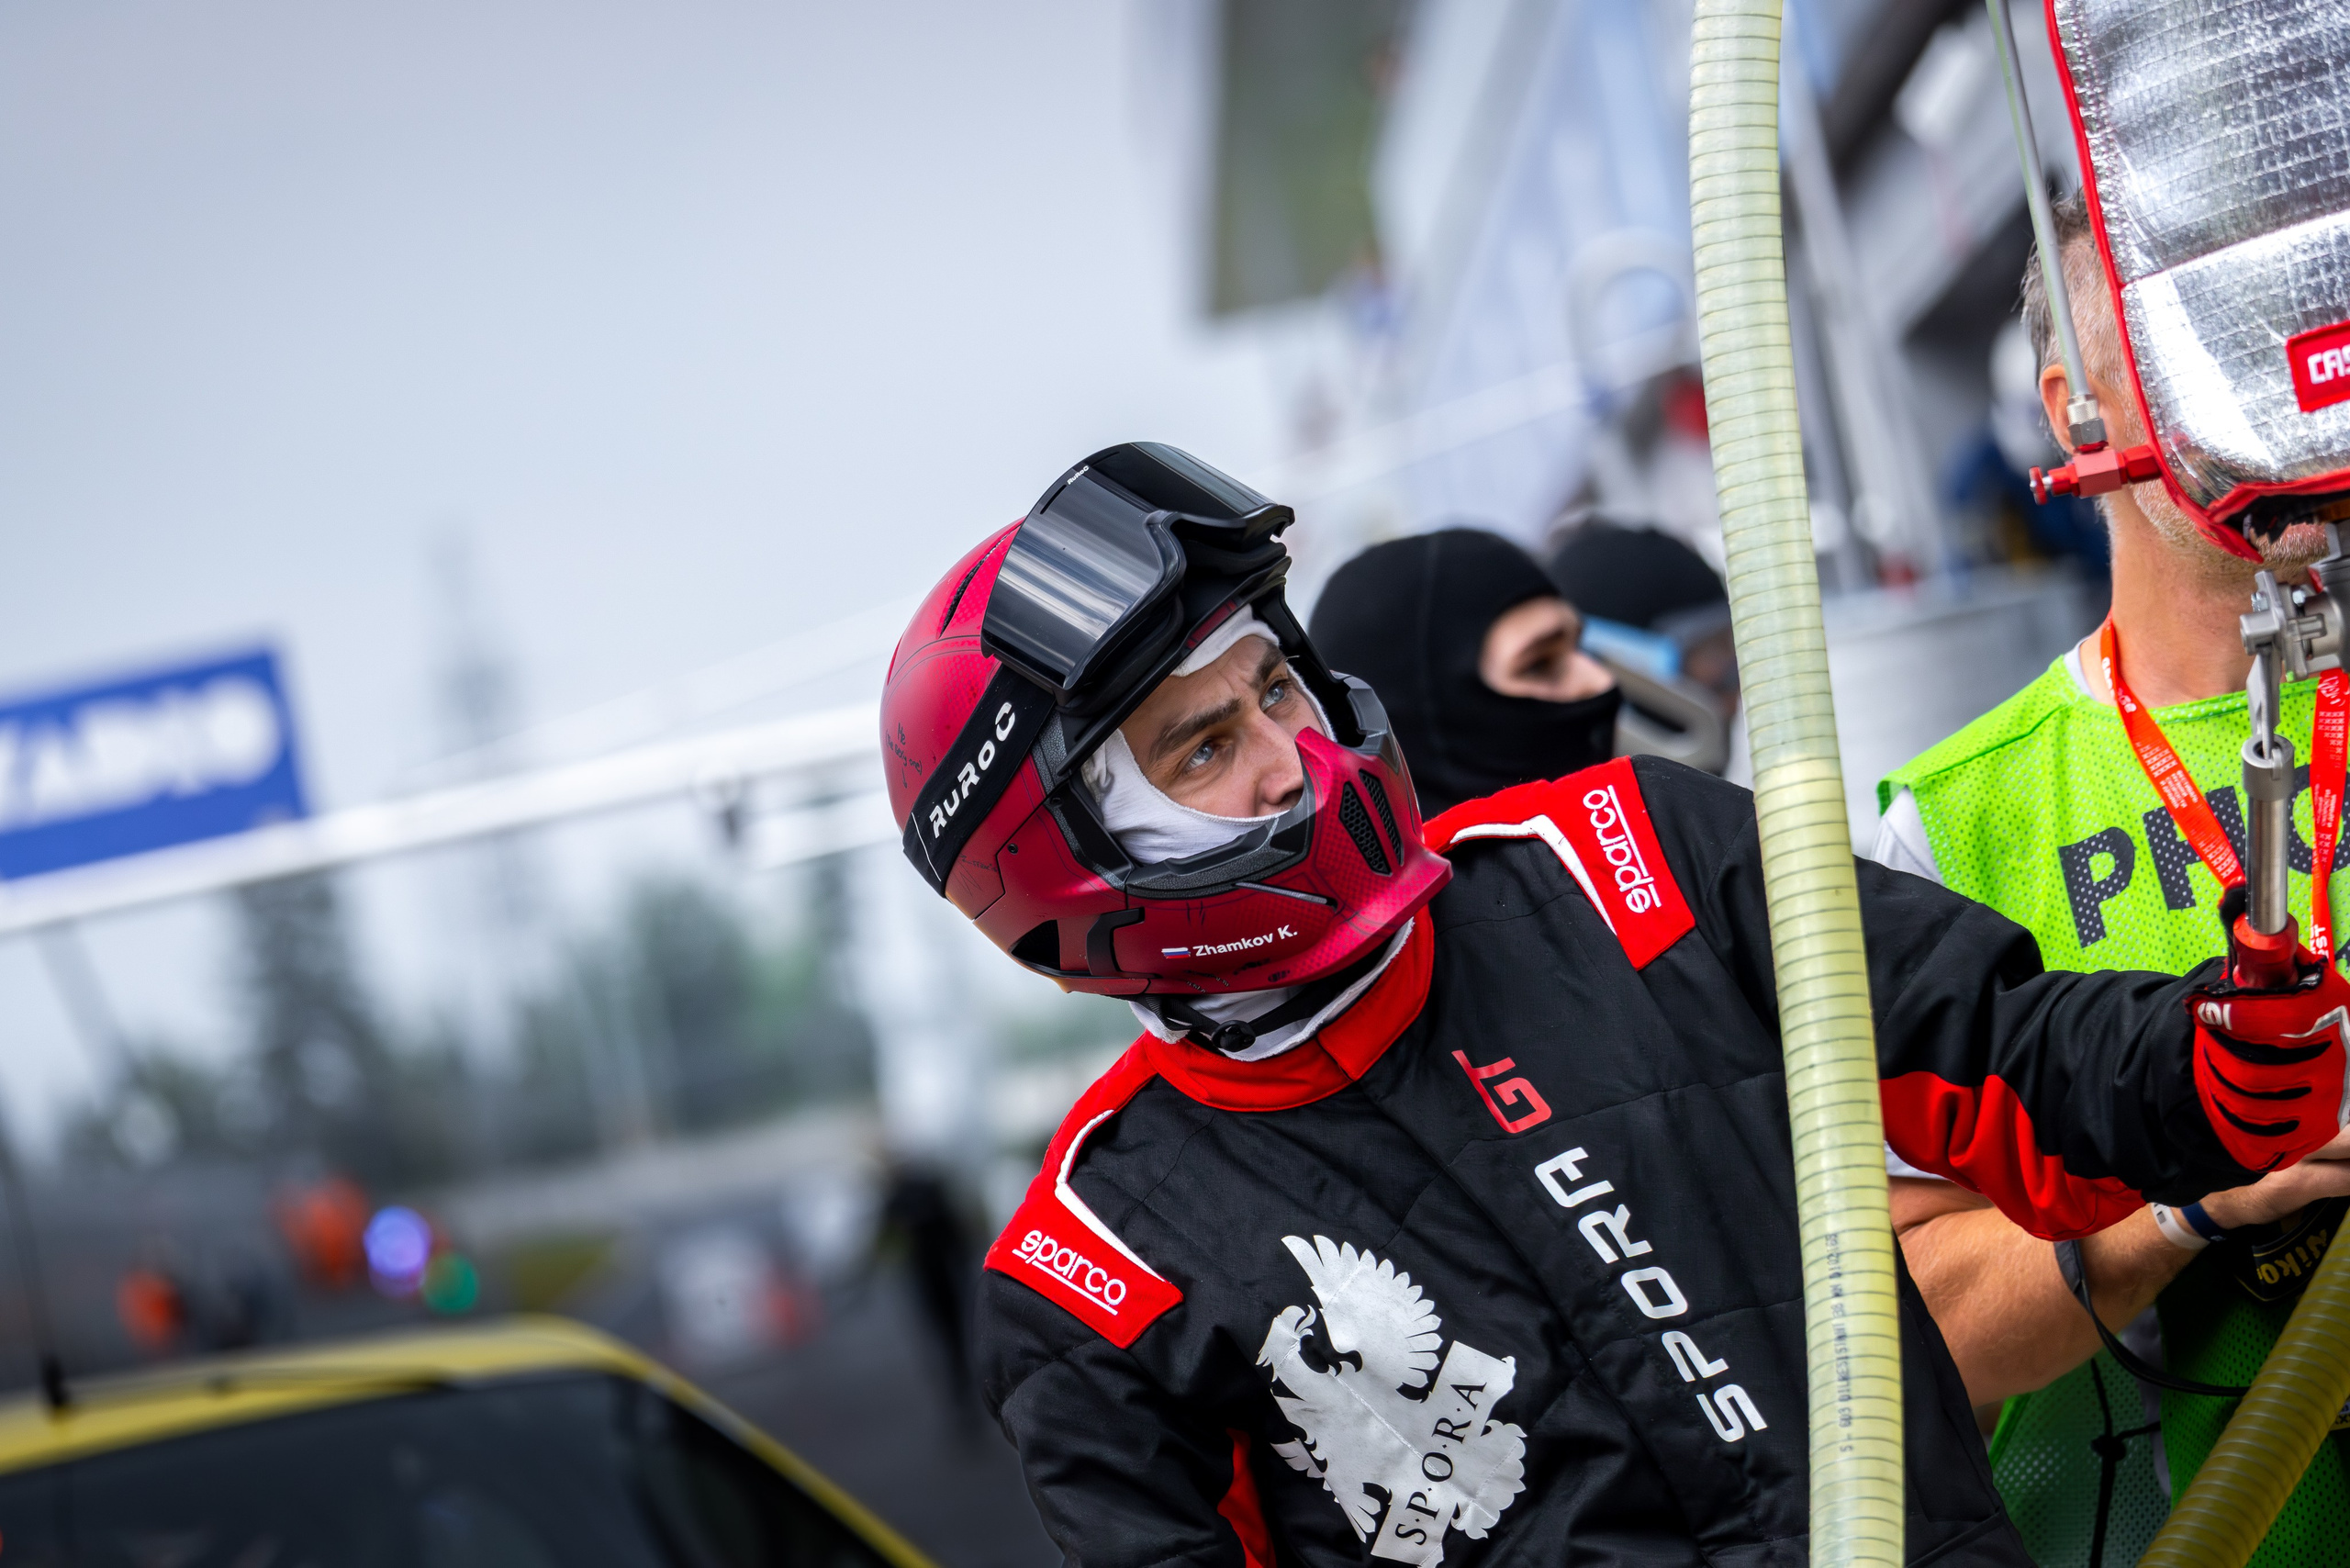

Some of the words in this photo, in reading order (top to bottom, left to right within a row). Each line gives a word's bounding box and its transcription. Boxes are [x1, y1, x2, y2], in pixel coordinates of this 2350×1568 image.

[1583, 787, 1658, 914] sparco
[1192, 933, 1273, 957] Zhamkov
[1277, 924, 1298, 940] K.
[1451, 1049, 1552, 1134] GT
[1018, 1229, 1127, 1309] sparco
[1534, 1147, 1768, 1442] SPORA
[2256, 1228, 2328, 1284] Niko
